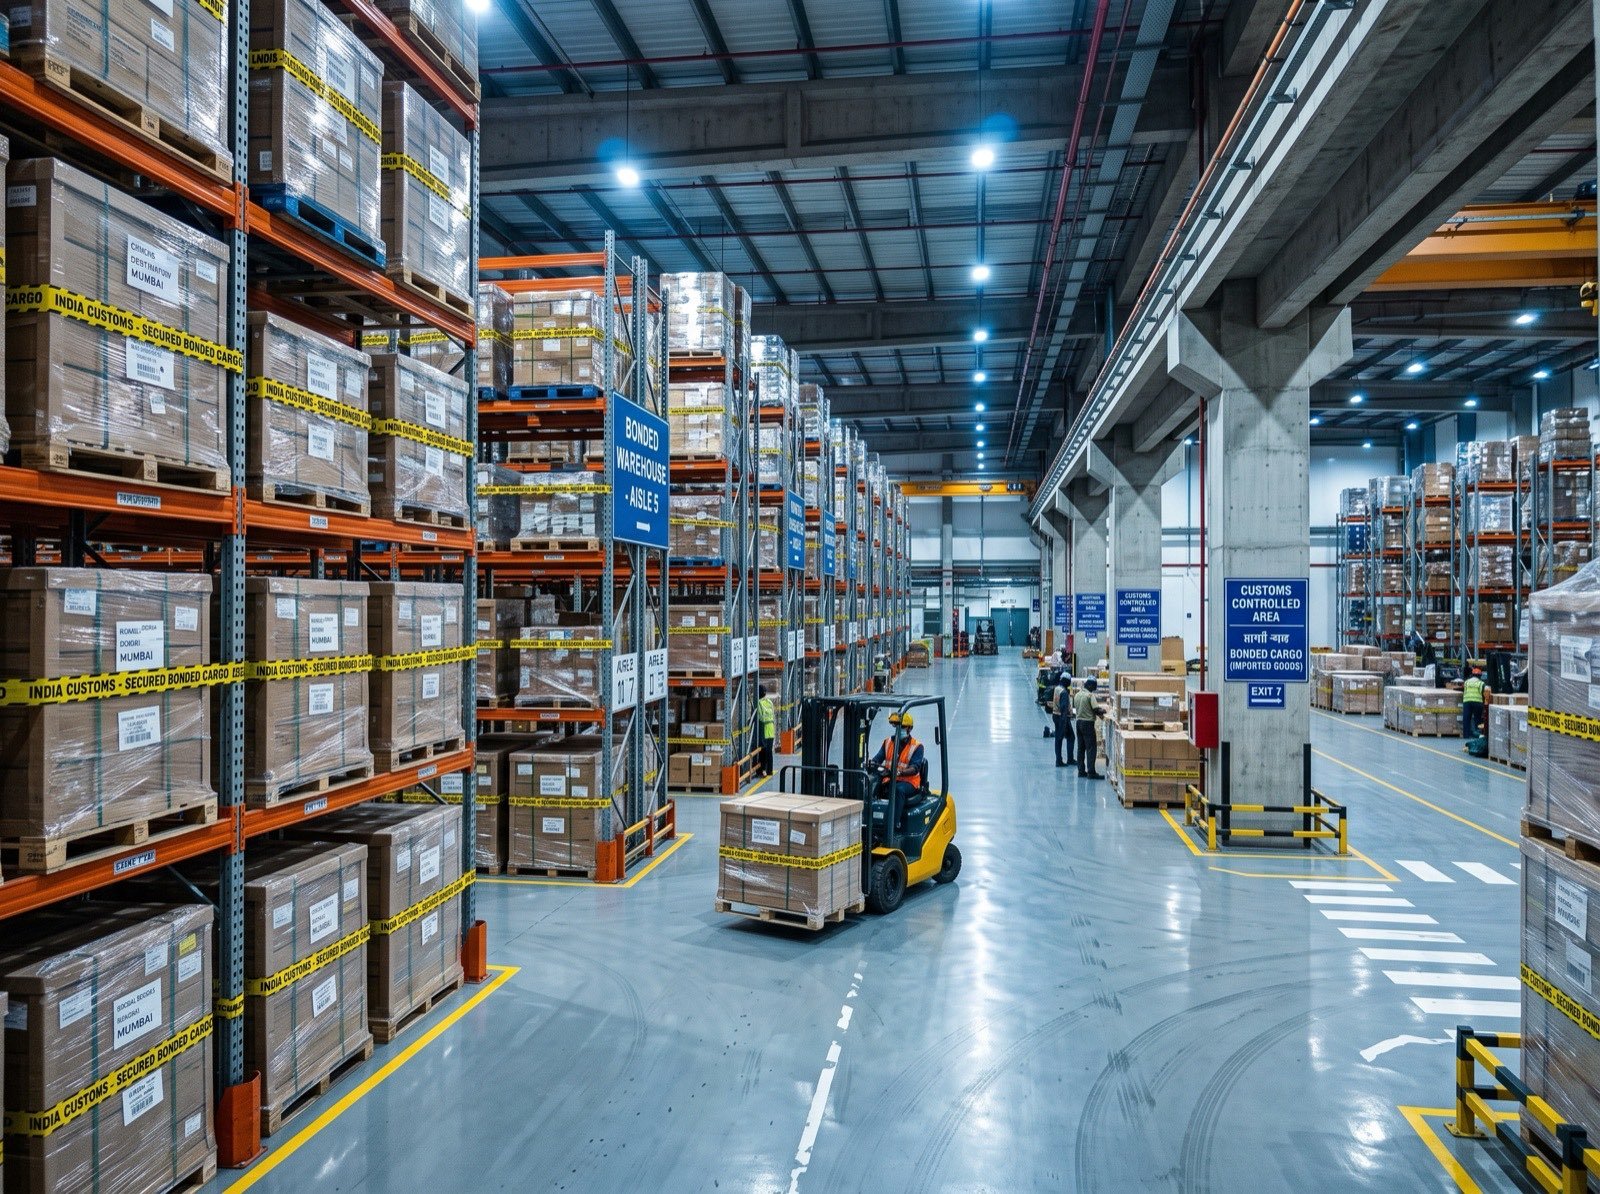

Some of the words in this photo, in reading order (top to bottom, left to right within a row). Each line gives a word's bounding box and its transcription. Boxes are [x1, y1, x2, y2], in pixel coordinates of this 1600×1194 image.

[131, 268, 164, 290] MUMBAI
[55, 293, 84, 315] INDIA
[87, 304, 134, 331] CUSTOMS
[142, 323, 181, 347] SECURED
[183, 338, 215, 359] BONDED
[266, 383, 285, 398] INDIA
[286, 389, 313, 407] CUSTOMS
[317, 400, 341, 416] SECURED
[625, 415, 659, 452] BONDED
[616, 445, 667, 486] WAREHOUSE
[629, 485, 652, 512] AISLE
[653, 493, 659, 514] 5
[1240, 585, 1292, 596] CUSTOMS
[1231, 598, 1301, 609] CONTROLLED
[1252, 611, 1280, 622] AREA
[120, 651, 153, 662] MUMBAI
[1230, 649, 1268, 659] BONDED
[1270, 648, 1303, 659] CARGO
[256, 665, 277, 676] INDIA
[279, 663, 308, 675] CUSTOMS
[1230, 661, 1272, 671] (IMPORTED
[29, 684, 62, 699] INDIA
[66, 679, 115, 696] CUSTOMS
[125, 674, 165, 690] SECURED
[168, 671, 200, 685] BONDED
[202, 668, 228, 681] CARGO
[1251, 686, 1273, 696] EXIT
[1275, 686, 1282, 696] 7
[260, 976, 282, 992] INDIA
[283, 960, 311, 983] CUSTOMS
[315, 946, 339, 966] SECURED
[117, 1012, 153, 1039] MUMBAI
[29, 1110, 61, 1131] INDIA
[64, 1080, 109, 1118] CUSTOMS
[116, 1053, 155, 1086] SECURED
[157, 1034, 188, 1062] BONDED
